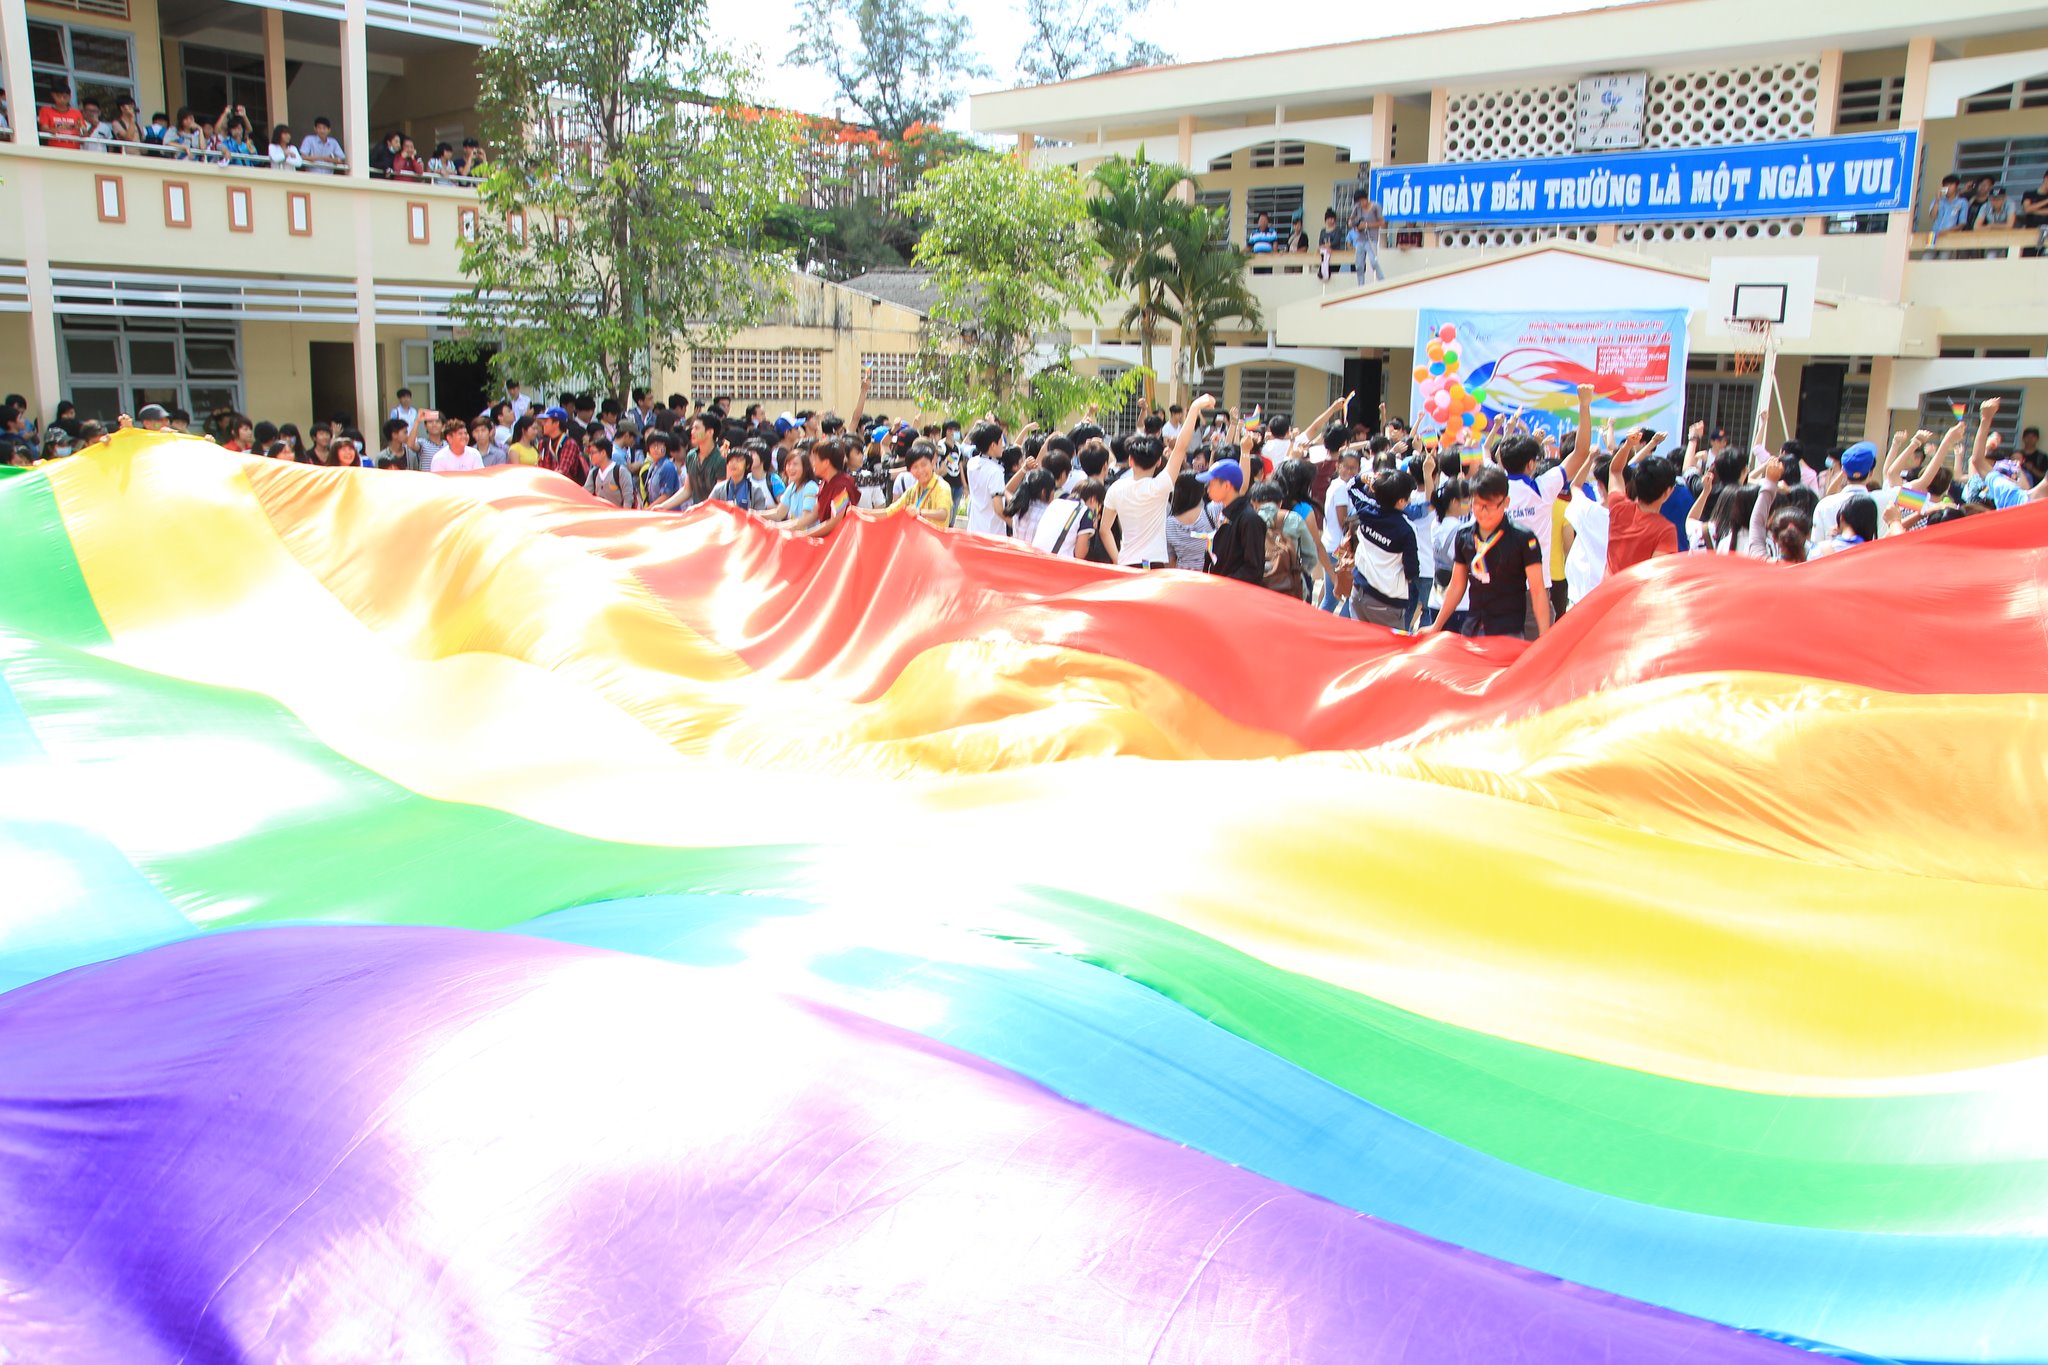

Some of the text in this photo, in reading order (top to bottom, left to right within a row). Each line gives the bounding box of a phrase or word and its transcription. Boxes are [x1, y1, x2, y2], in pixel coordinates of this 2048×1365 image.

[1382, 154, 1895, 216] MỖI NGÀY ĐẾN TRƯỜNG LÀ MỘT NGÀY VUI
[1365, 526, 1392, 547] PLAYBOY
